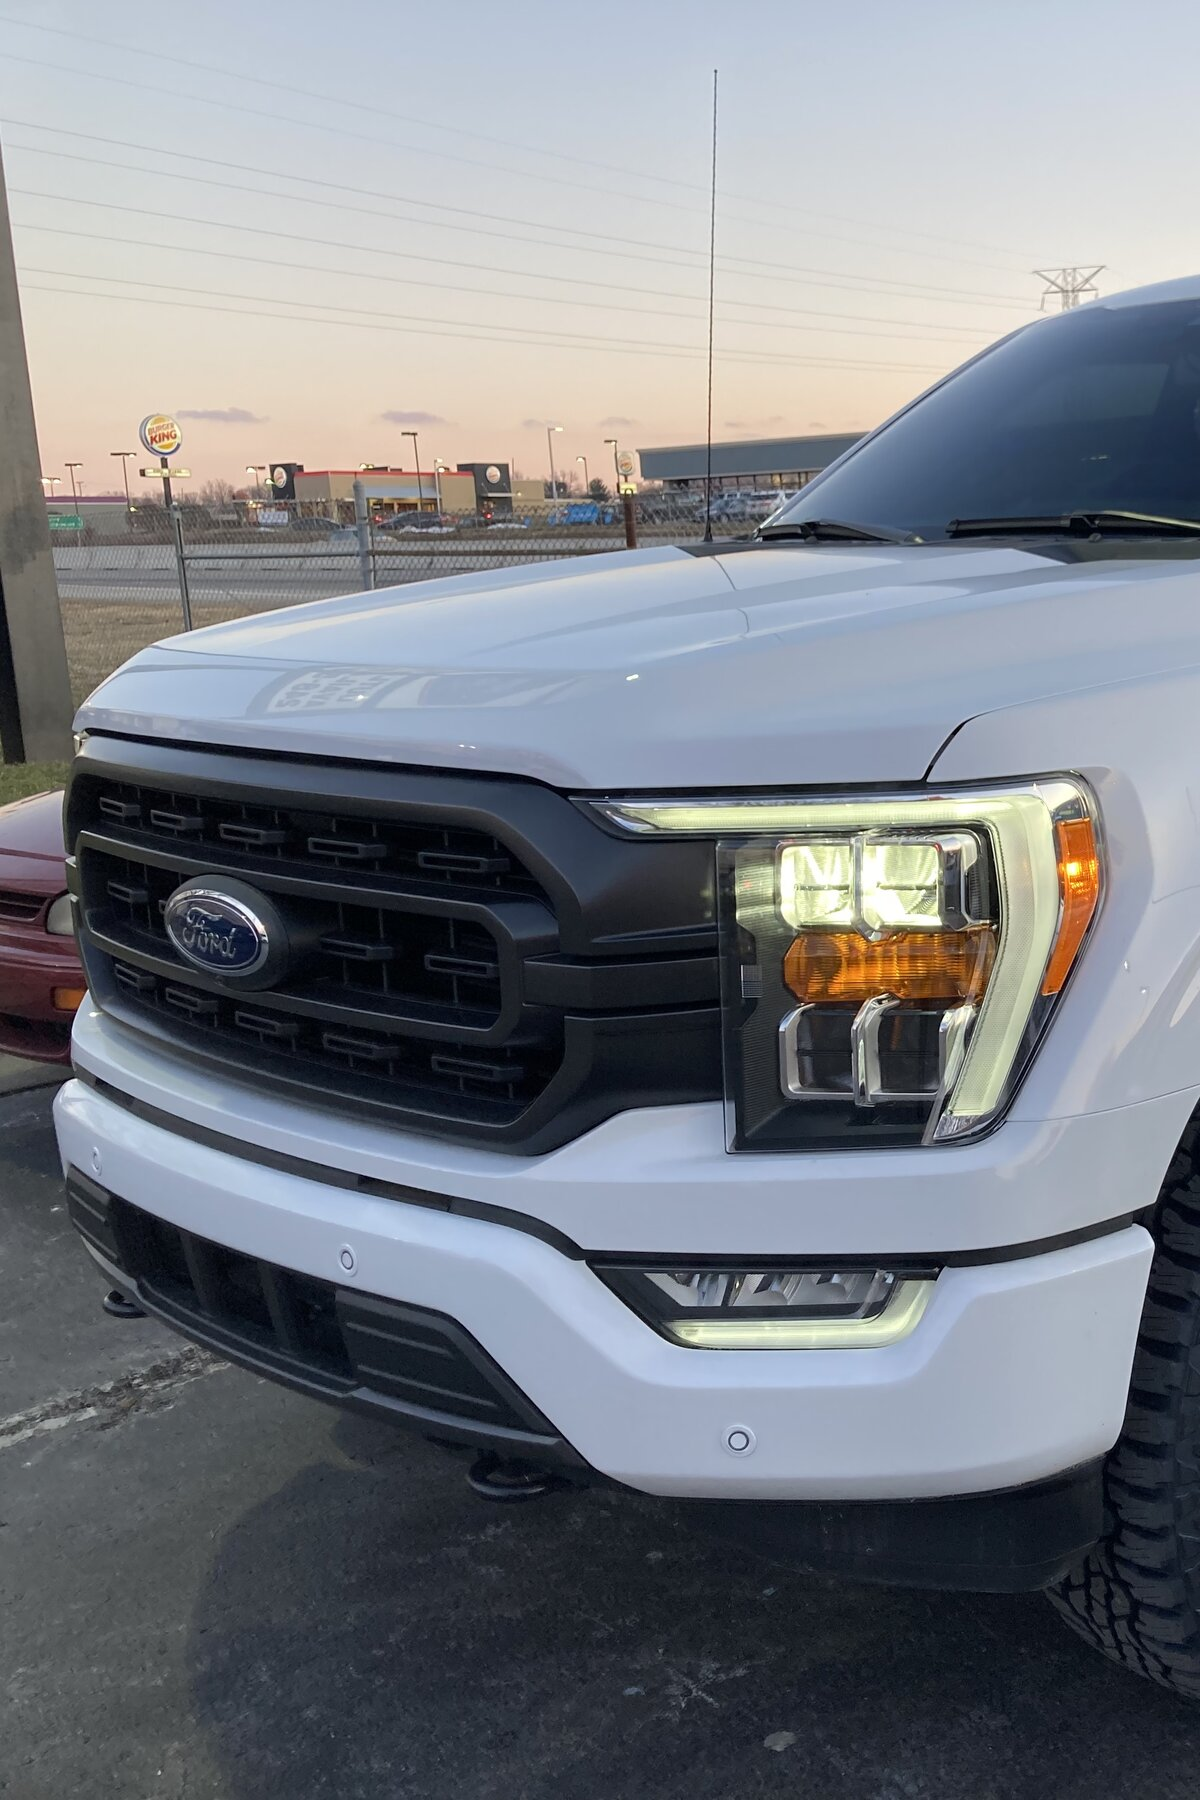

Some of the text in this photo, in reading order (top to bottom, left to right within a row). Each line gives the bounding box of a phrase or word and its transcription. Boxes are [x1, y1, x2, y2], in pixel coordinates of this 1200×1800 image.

[147, 422, 175, 436] BURGER
[149, 429, 177, 446] KING
[181, 906, 237, 959] Ford
